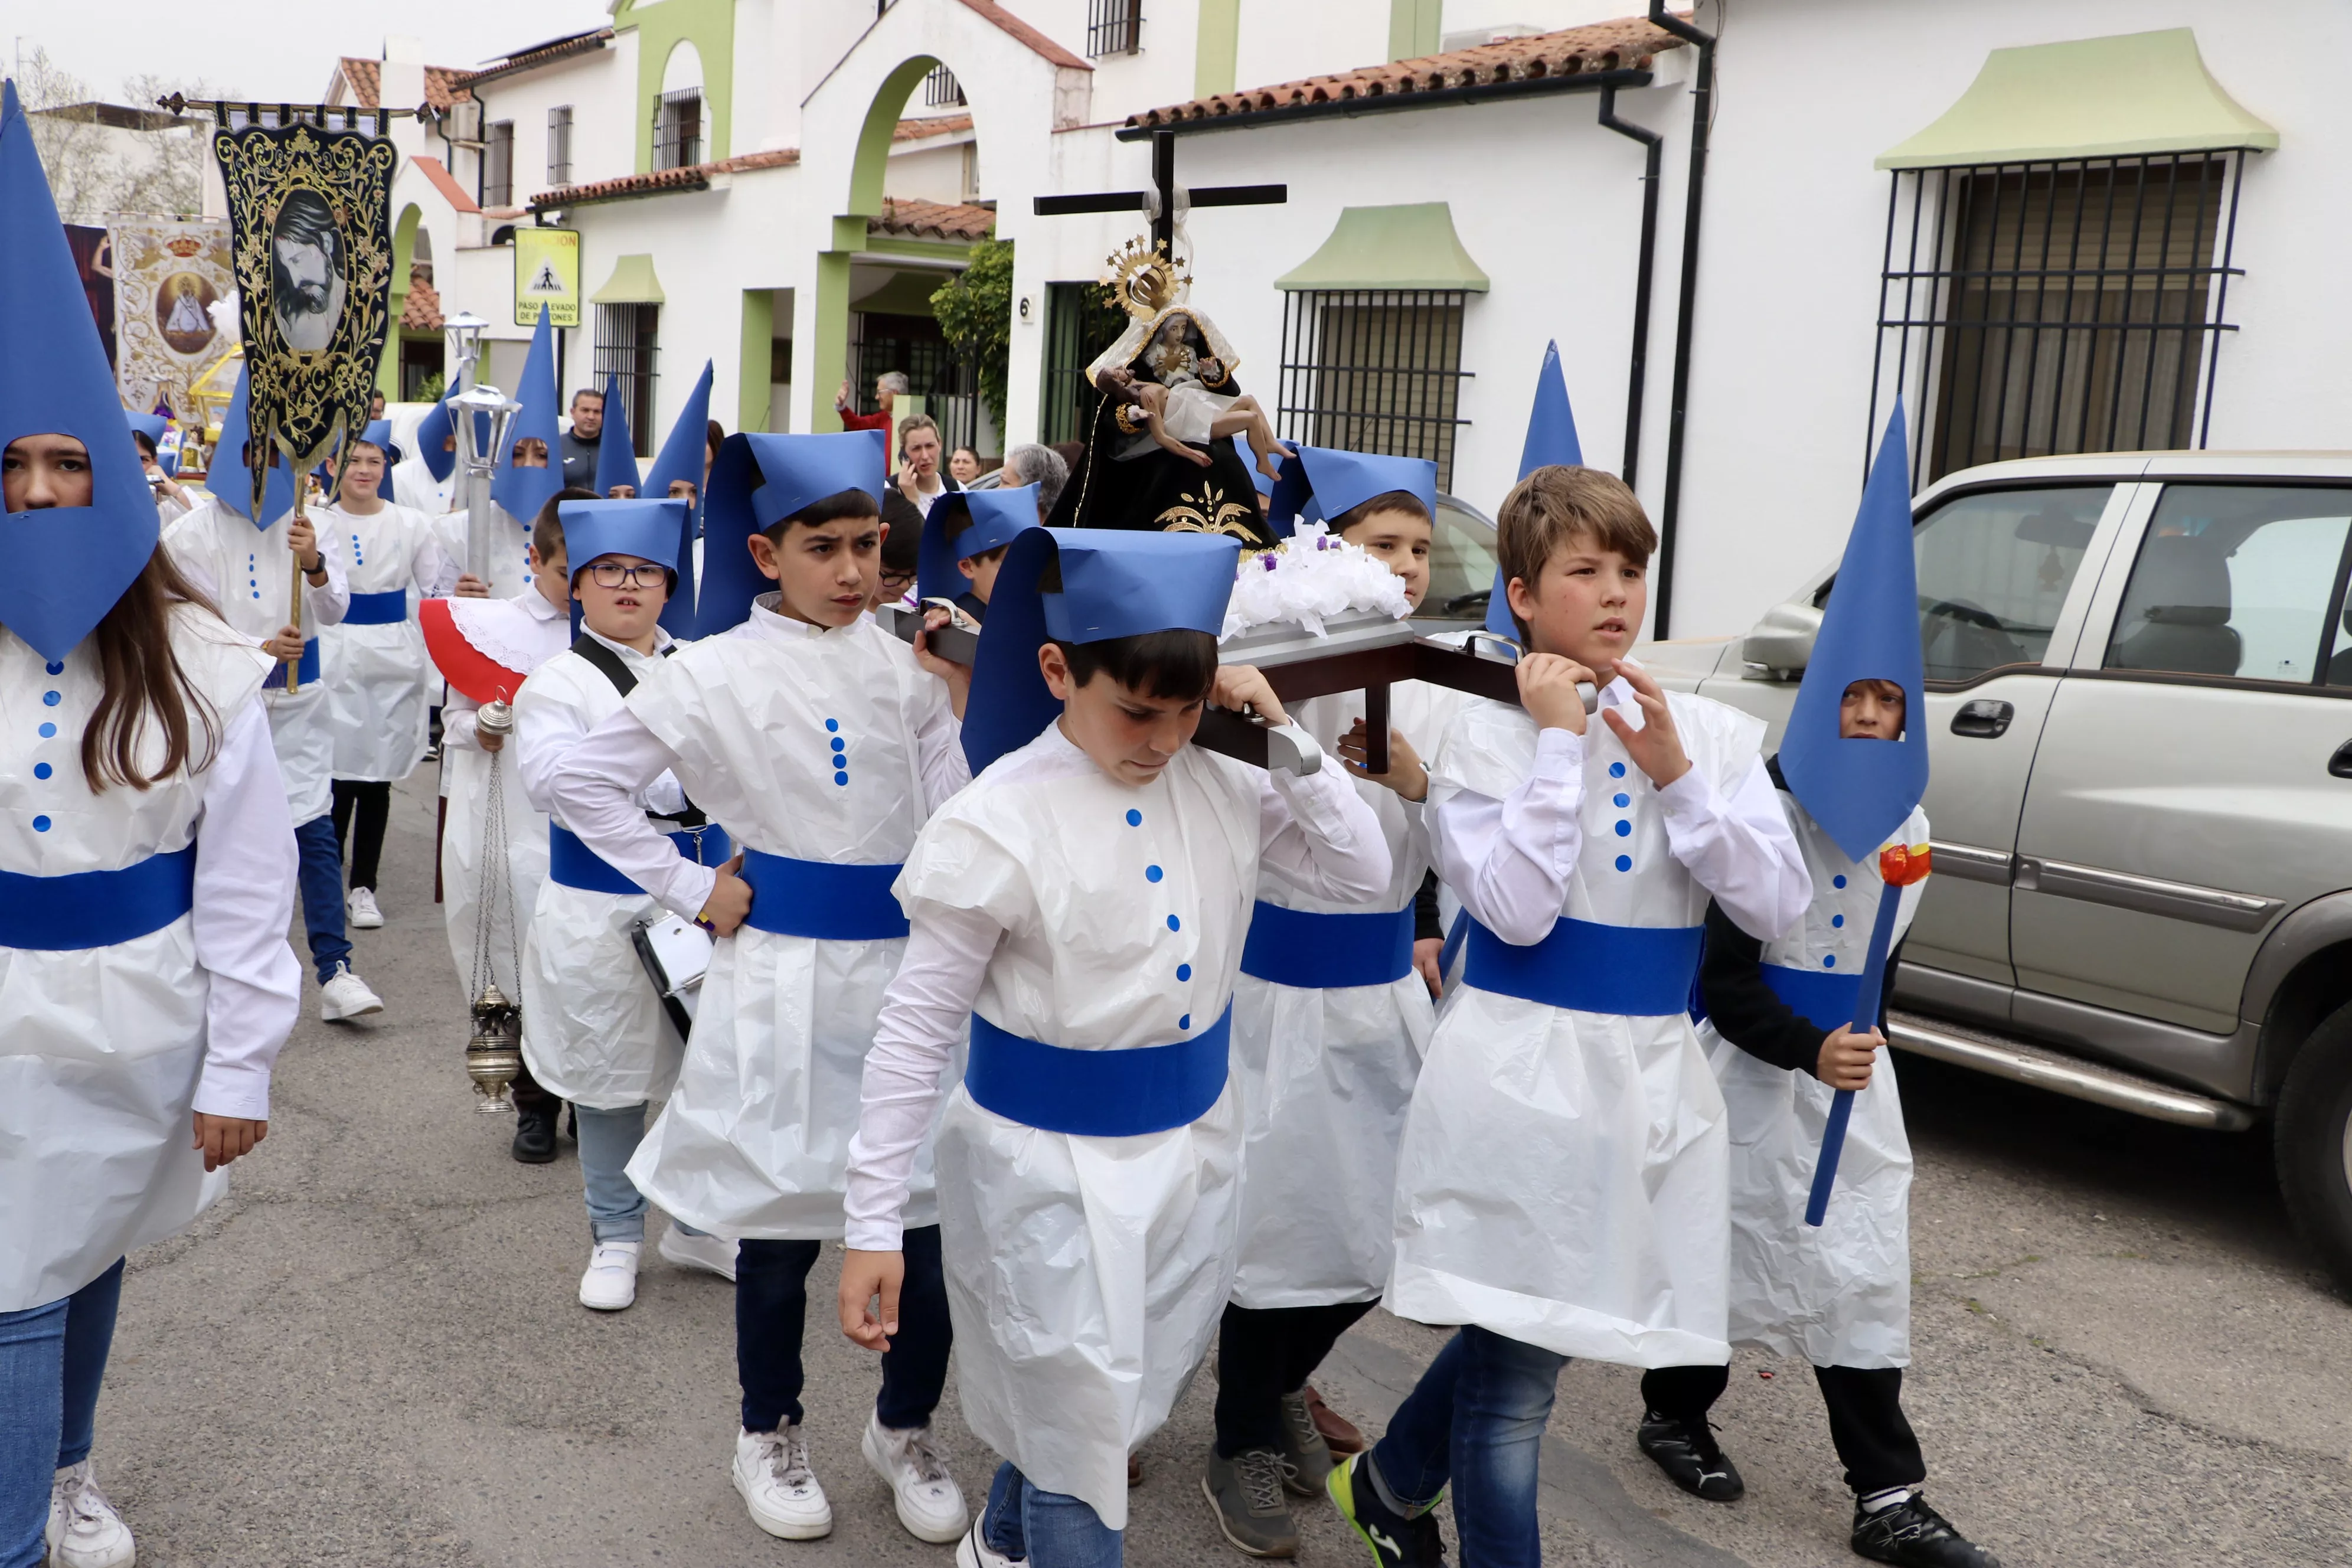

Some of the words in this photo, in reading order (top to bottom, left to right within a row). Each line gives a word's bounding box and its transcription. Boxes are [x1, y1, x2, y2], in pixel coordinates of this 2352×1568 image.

[518, 302, 538, 310] PASO
[541, 303, 576, 311] EVADO
[1020, 296, 1030, 316] 6
[533, 312, 573, 321] PONES
